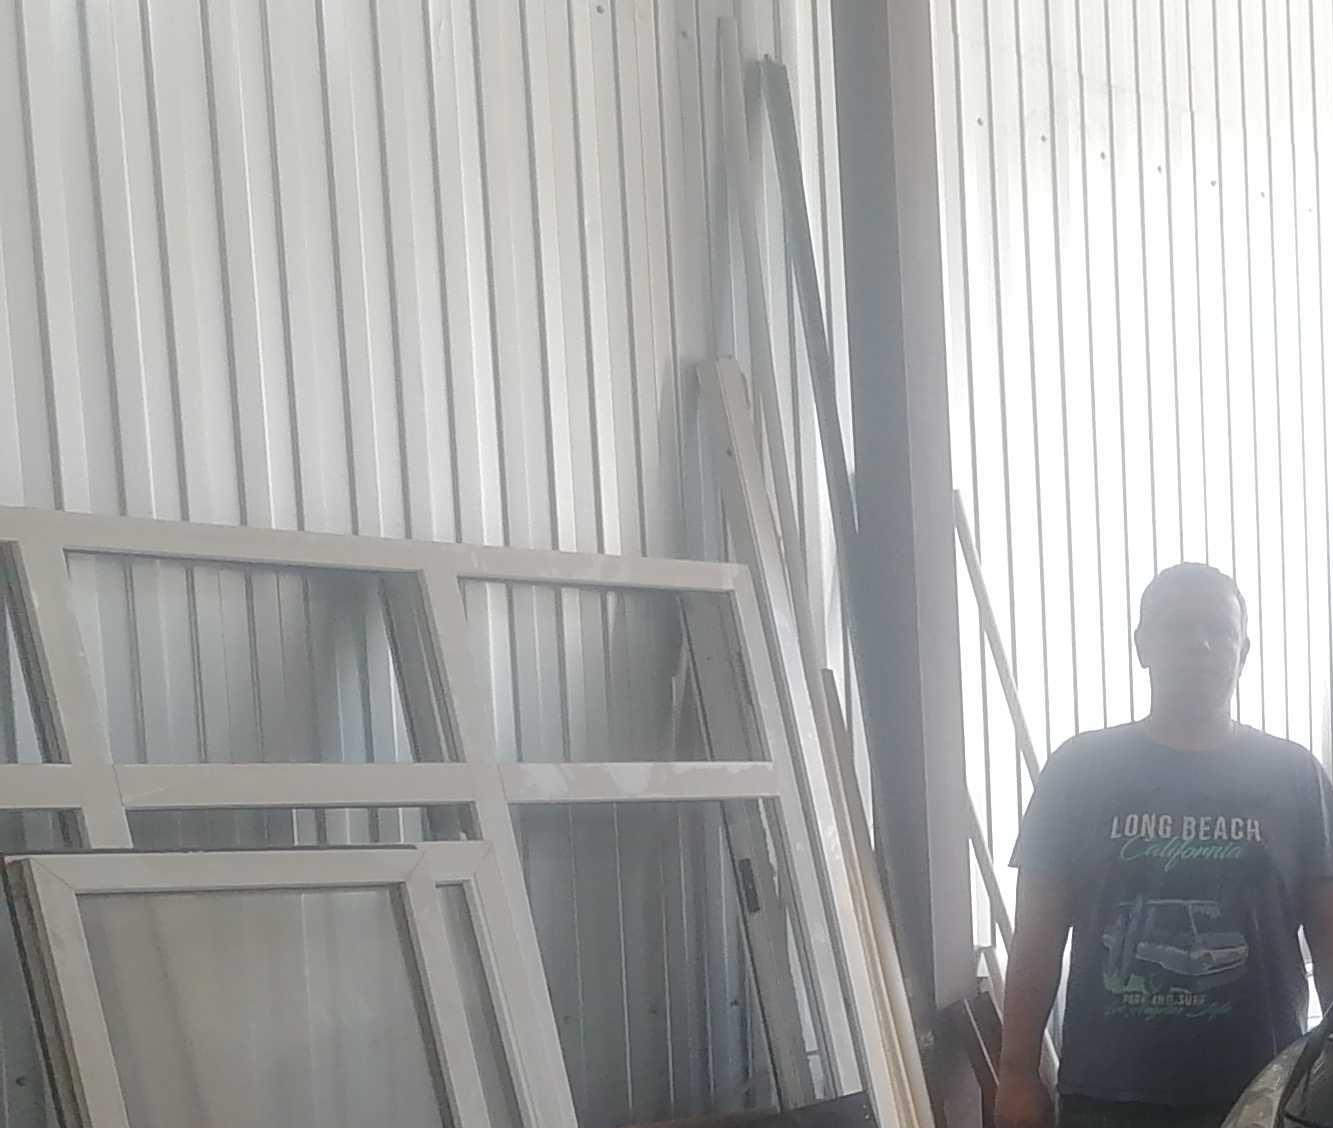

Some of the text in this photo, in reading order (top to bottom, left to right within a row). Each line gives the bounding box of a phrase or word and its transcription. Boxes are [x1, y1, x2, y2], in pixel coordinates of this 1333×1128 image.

[1110, 814, 1262, 843] LONG BEACH
[1120, 835, 1242, 872] California
